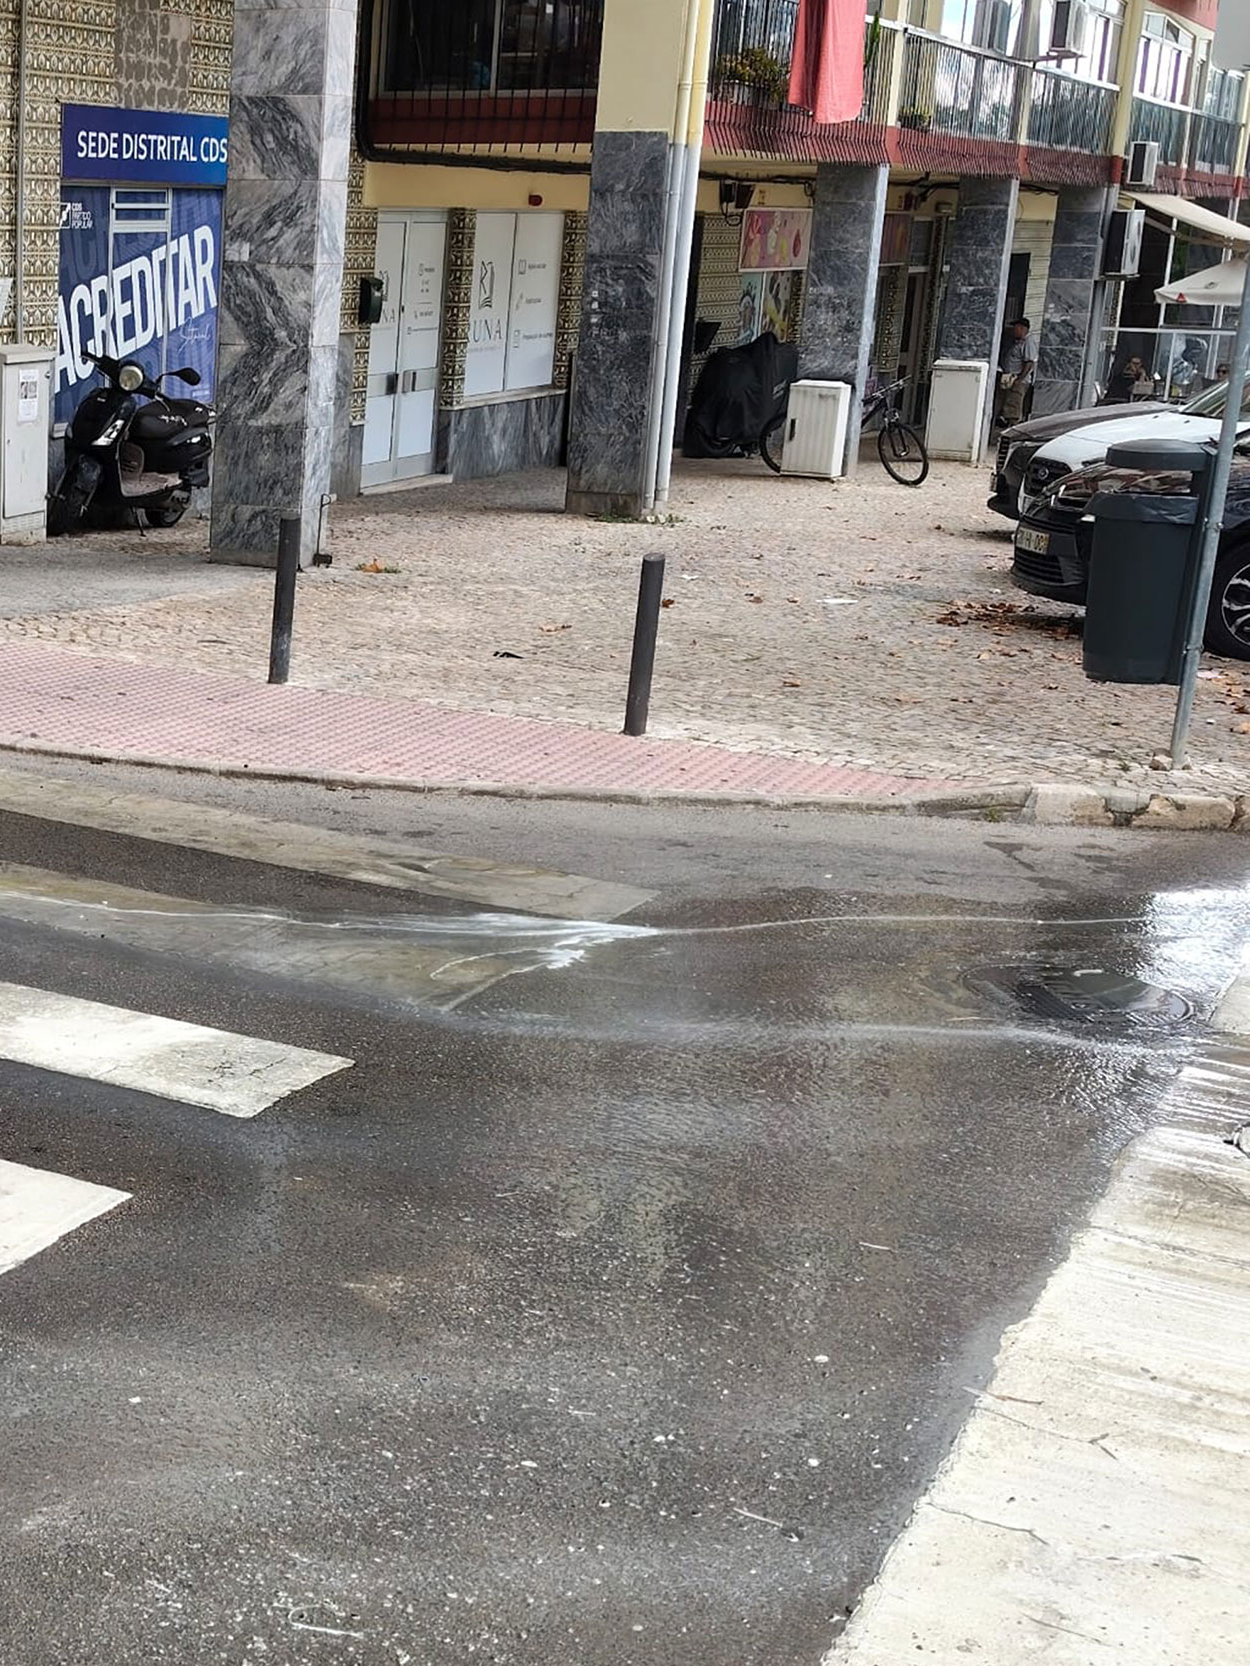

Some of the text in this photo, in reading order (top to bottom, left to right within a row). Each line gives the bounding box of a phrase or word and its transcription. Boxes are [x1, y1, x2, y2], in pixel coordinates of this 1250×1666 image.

[77, 130, 228, 163] SEDE DISTRITAL CDS
[54, 225, 217, 393] ACREDITAR
[469, 318, 502, 342] UNA
